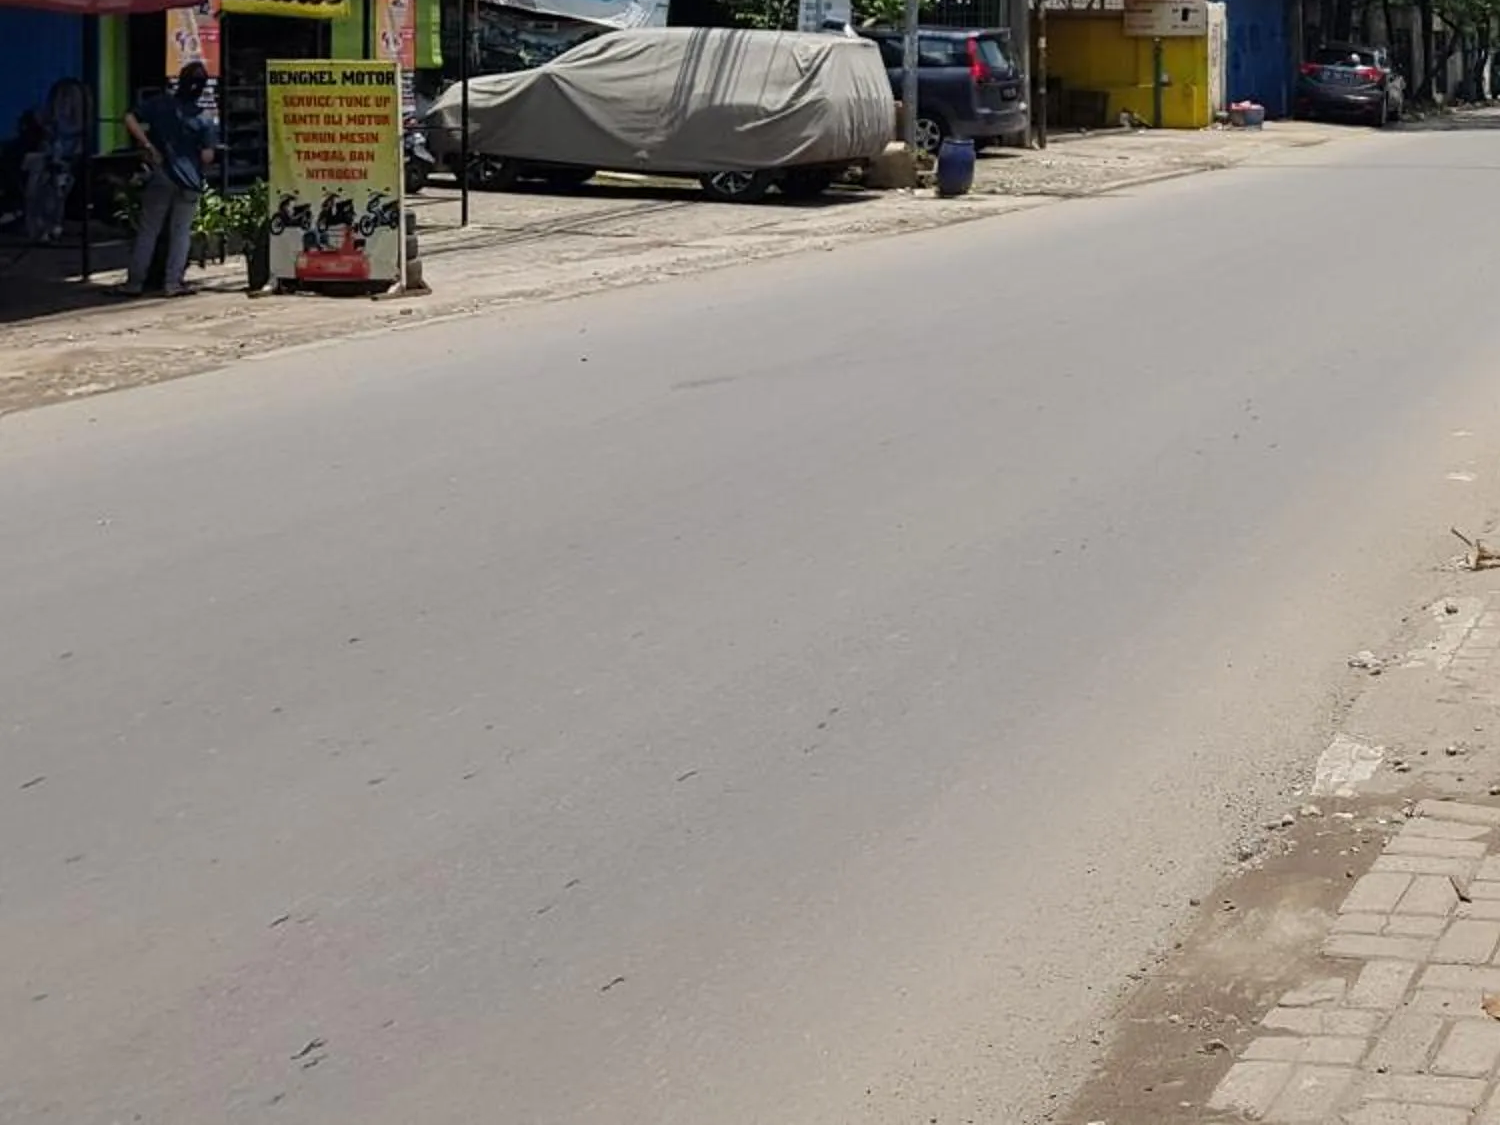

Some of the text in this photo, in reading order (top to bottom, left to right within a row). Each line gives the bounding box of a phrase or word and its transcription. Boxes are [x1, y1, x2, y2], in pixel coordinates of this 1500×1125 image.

[269, 71, 396, 86] BENGKEL MOTOR
[375, 95, 391, 108] UP
[346, 114, 391, 126] MOTOR
